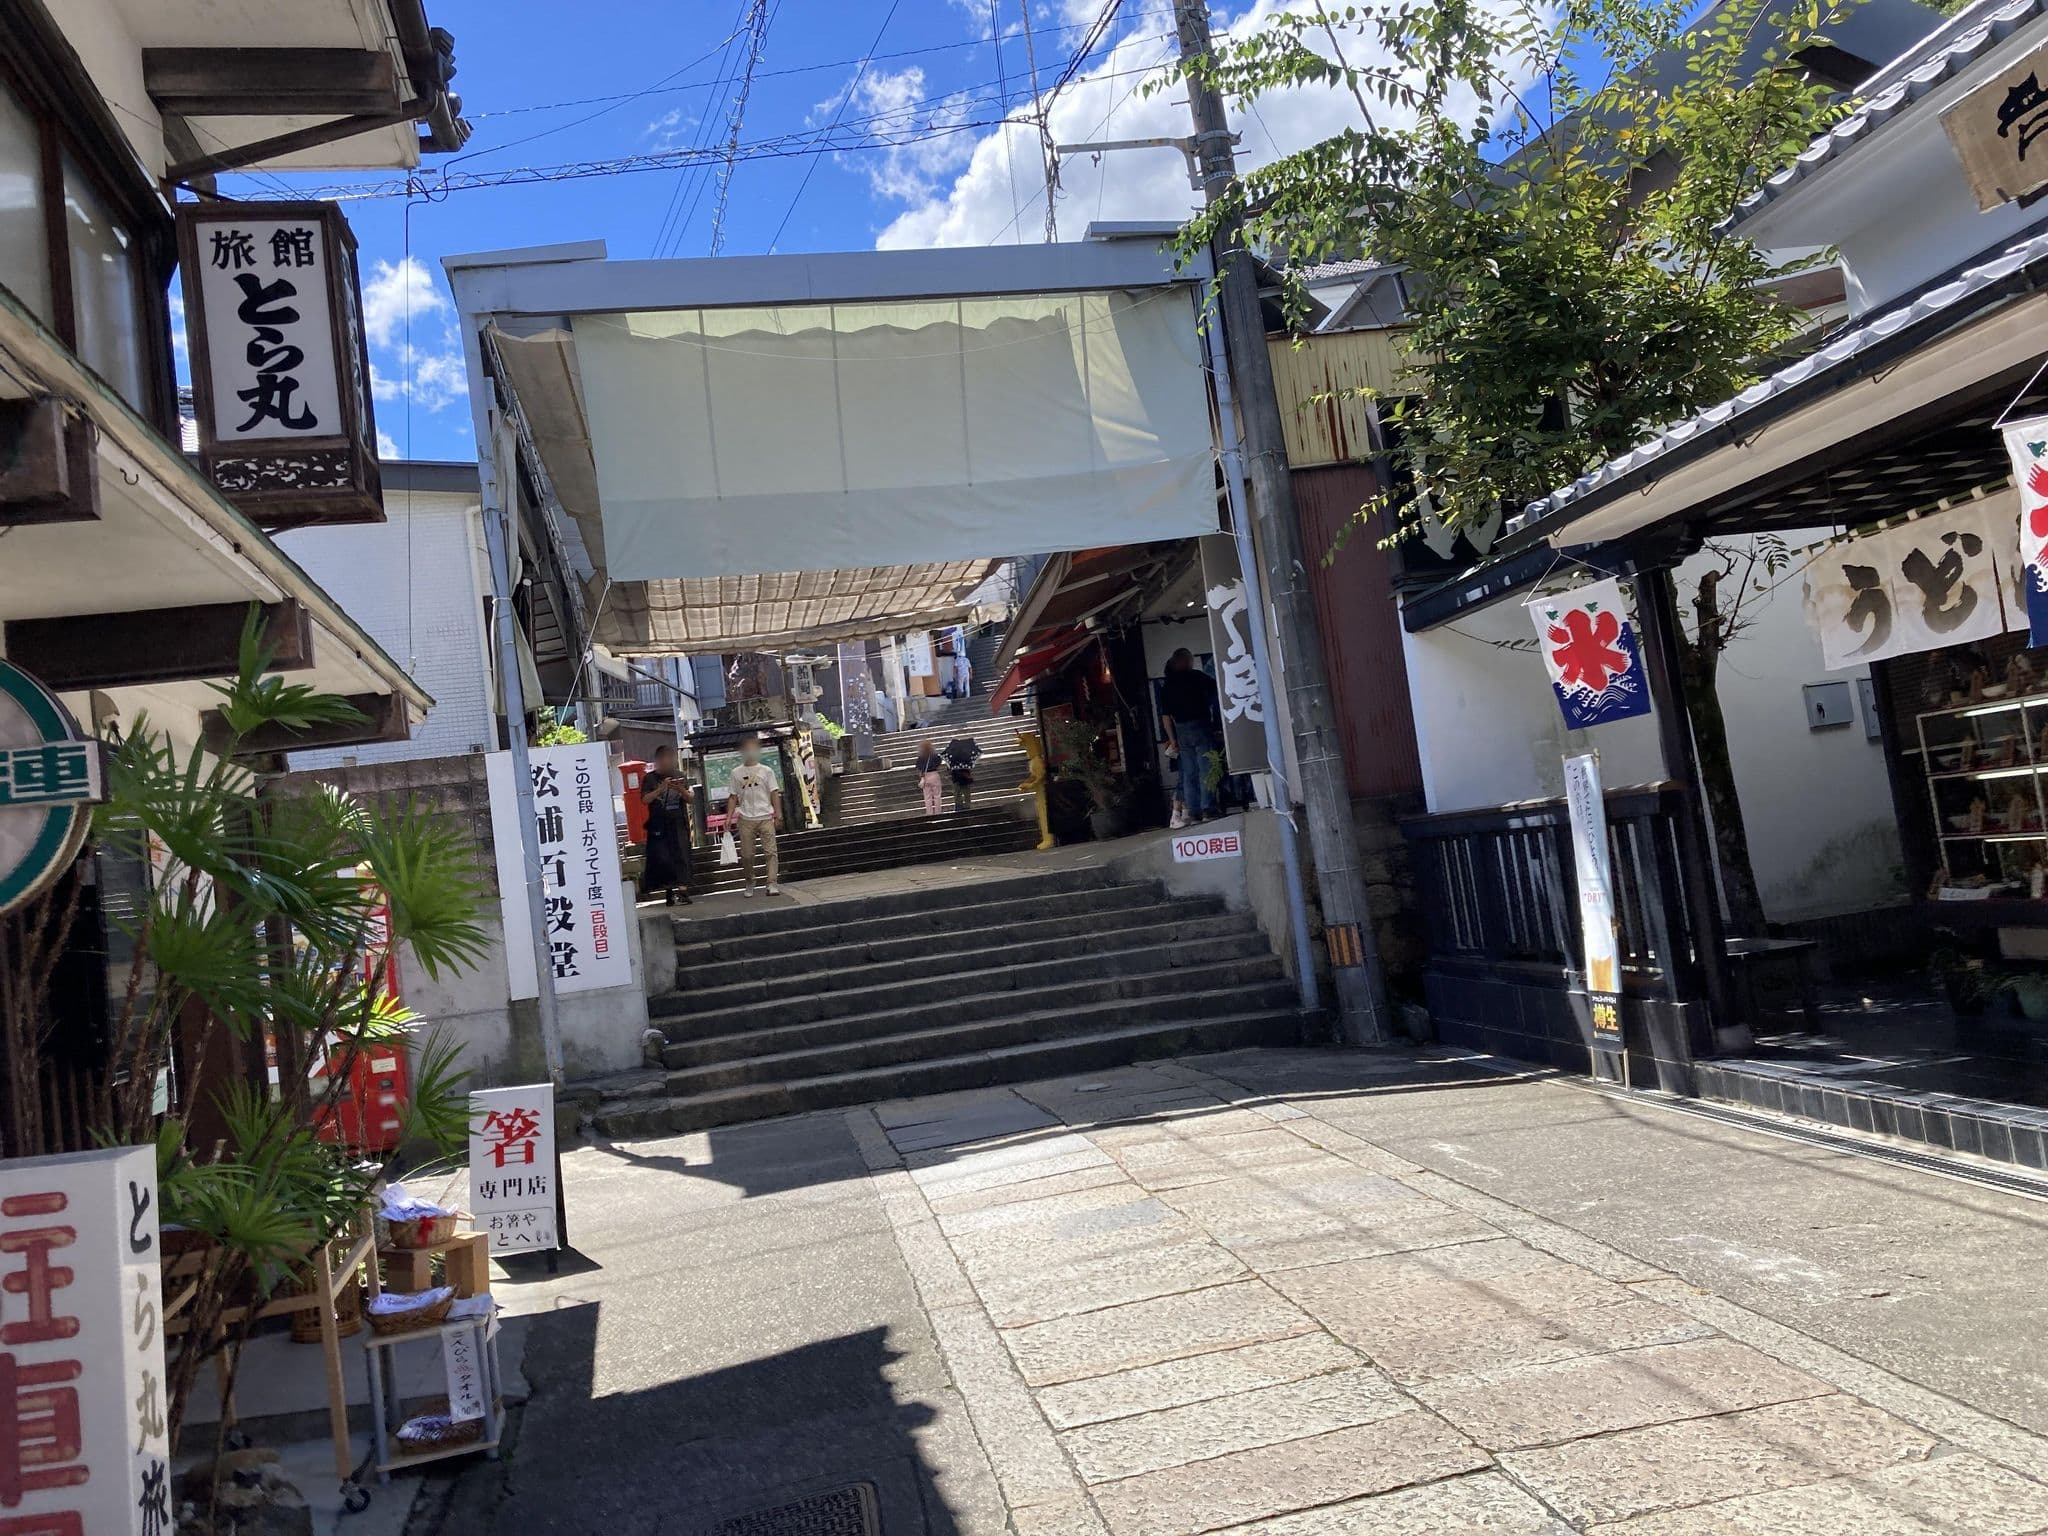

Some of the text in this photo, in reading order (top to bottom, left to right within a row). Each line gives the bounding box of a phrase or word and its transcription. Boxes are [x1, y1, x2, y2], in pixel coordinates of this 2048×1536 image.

[210, 226, 315, 271] 旅館
[232, 272, 318, 433] とら丸
[1842, 514, 2027, 657] うど
[1174, 835, 1239, 859] 100段目
[482, 1107, 542, 1169] 箸
[479, 1175, 547, 1200] 専門店
